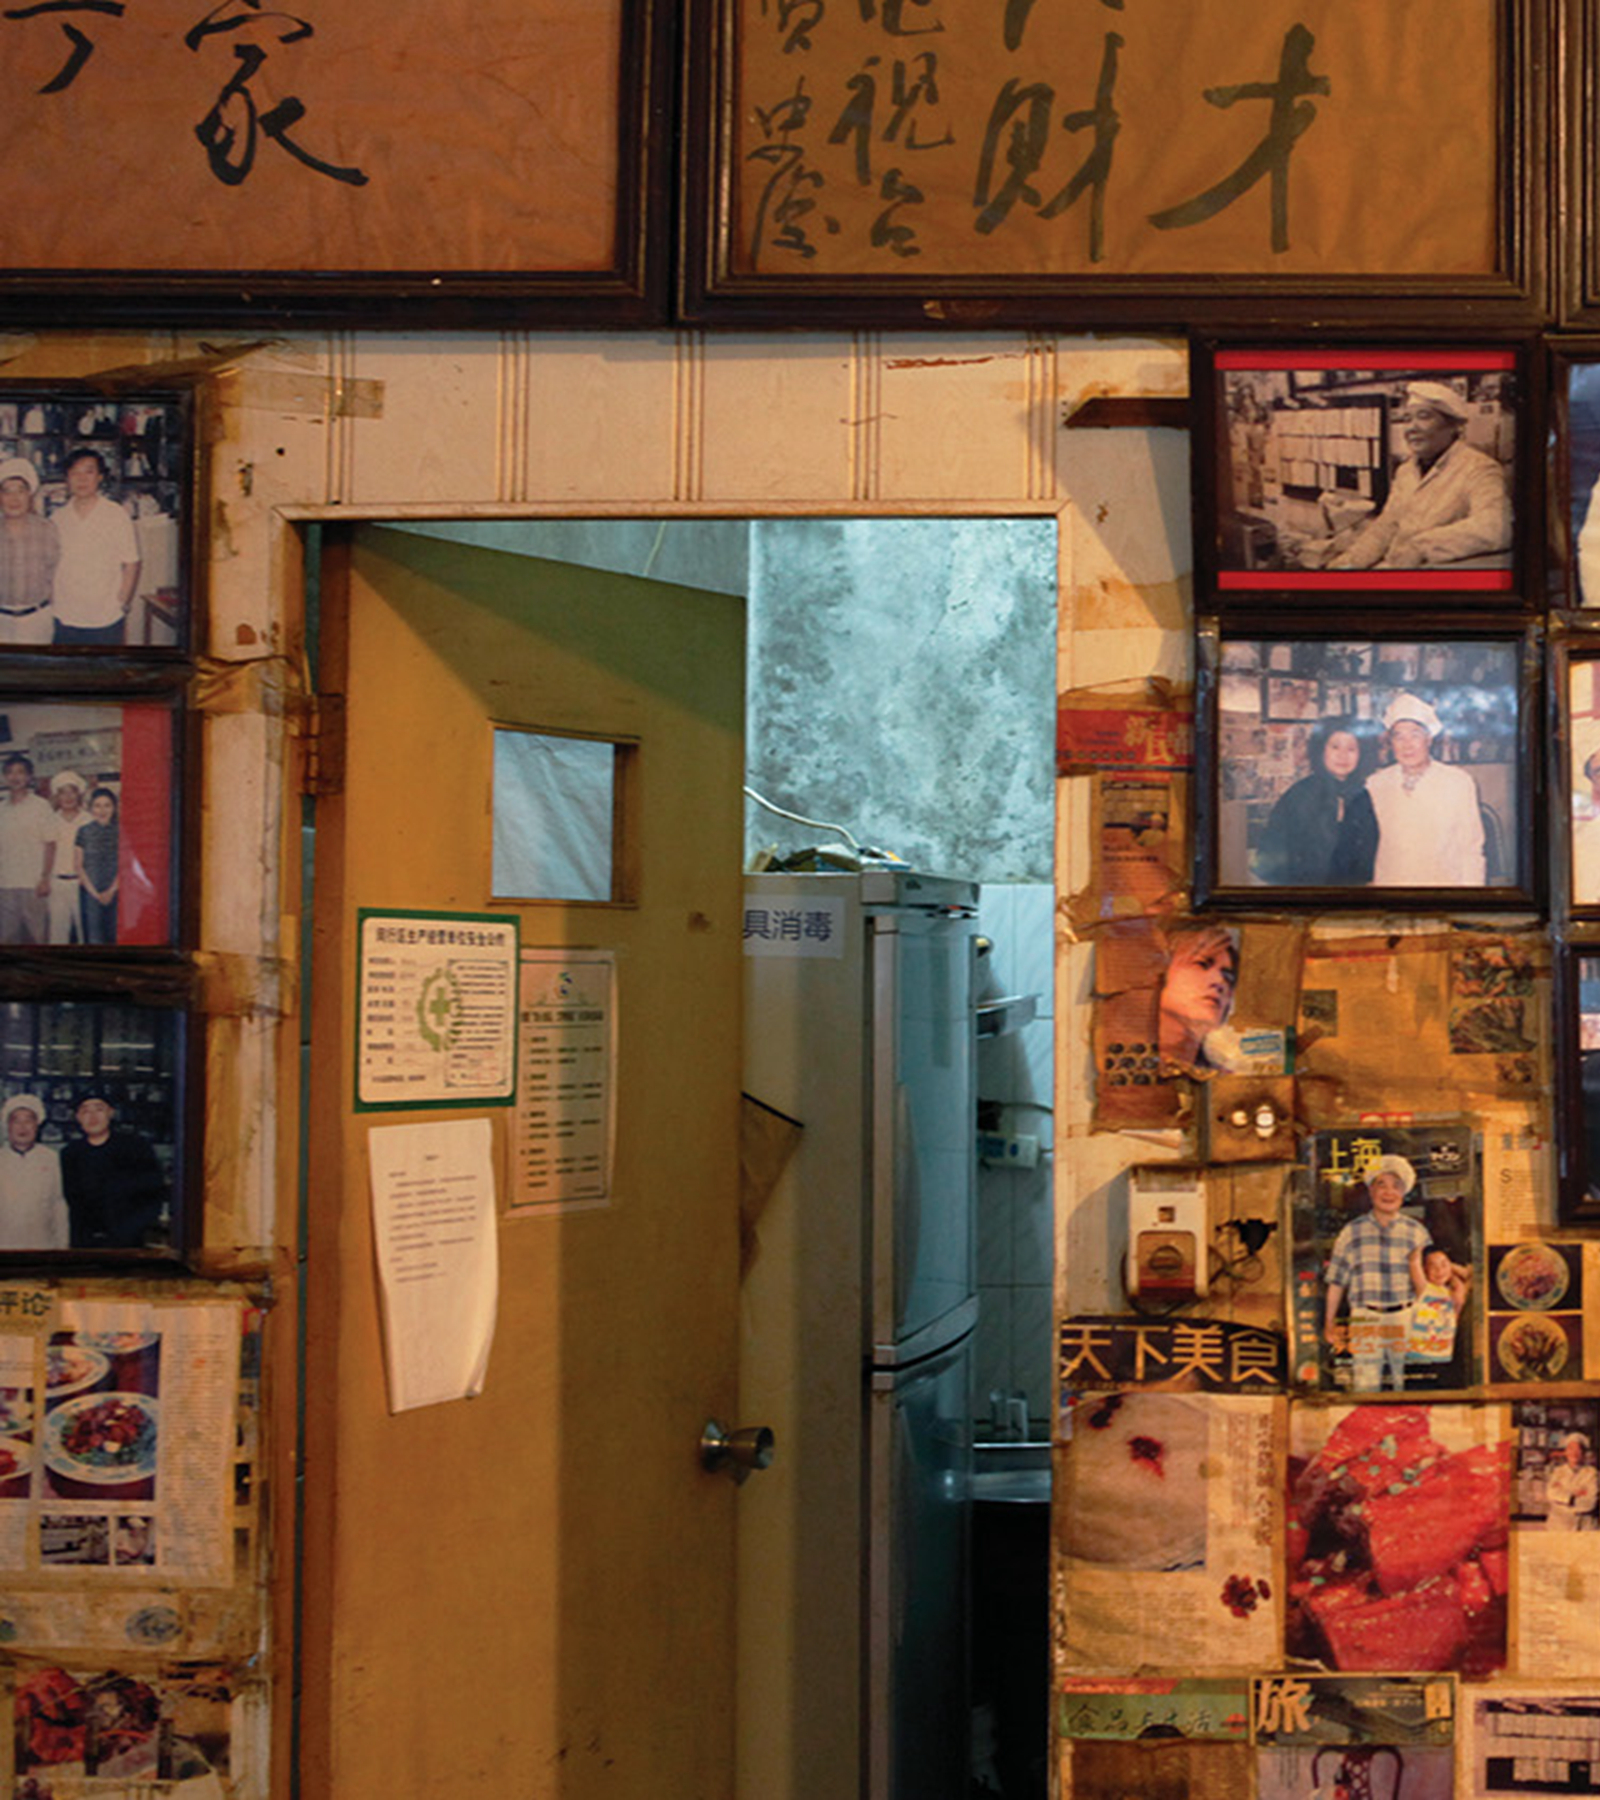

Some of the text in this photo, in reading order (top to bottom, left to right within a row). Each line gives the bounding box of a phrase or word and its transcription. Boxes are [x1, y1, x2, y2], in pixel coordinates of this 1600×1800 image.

[973, 0, 1126, 262] 财
[1319, 1138, 1382, 1174] 上海
[1060, 1322, 1281, 1385] 天下美食
